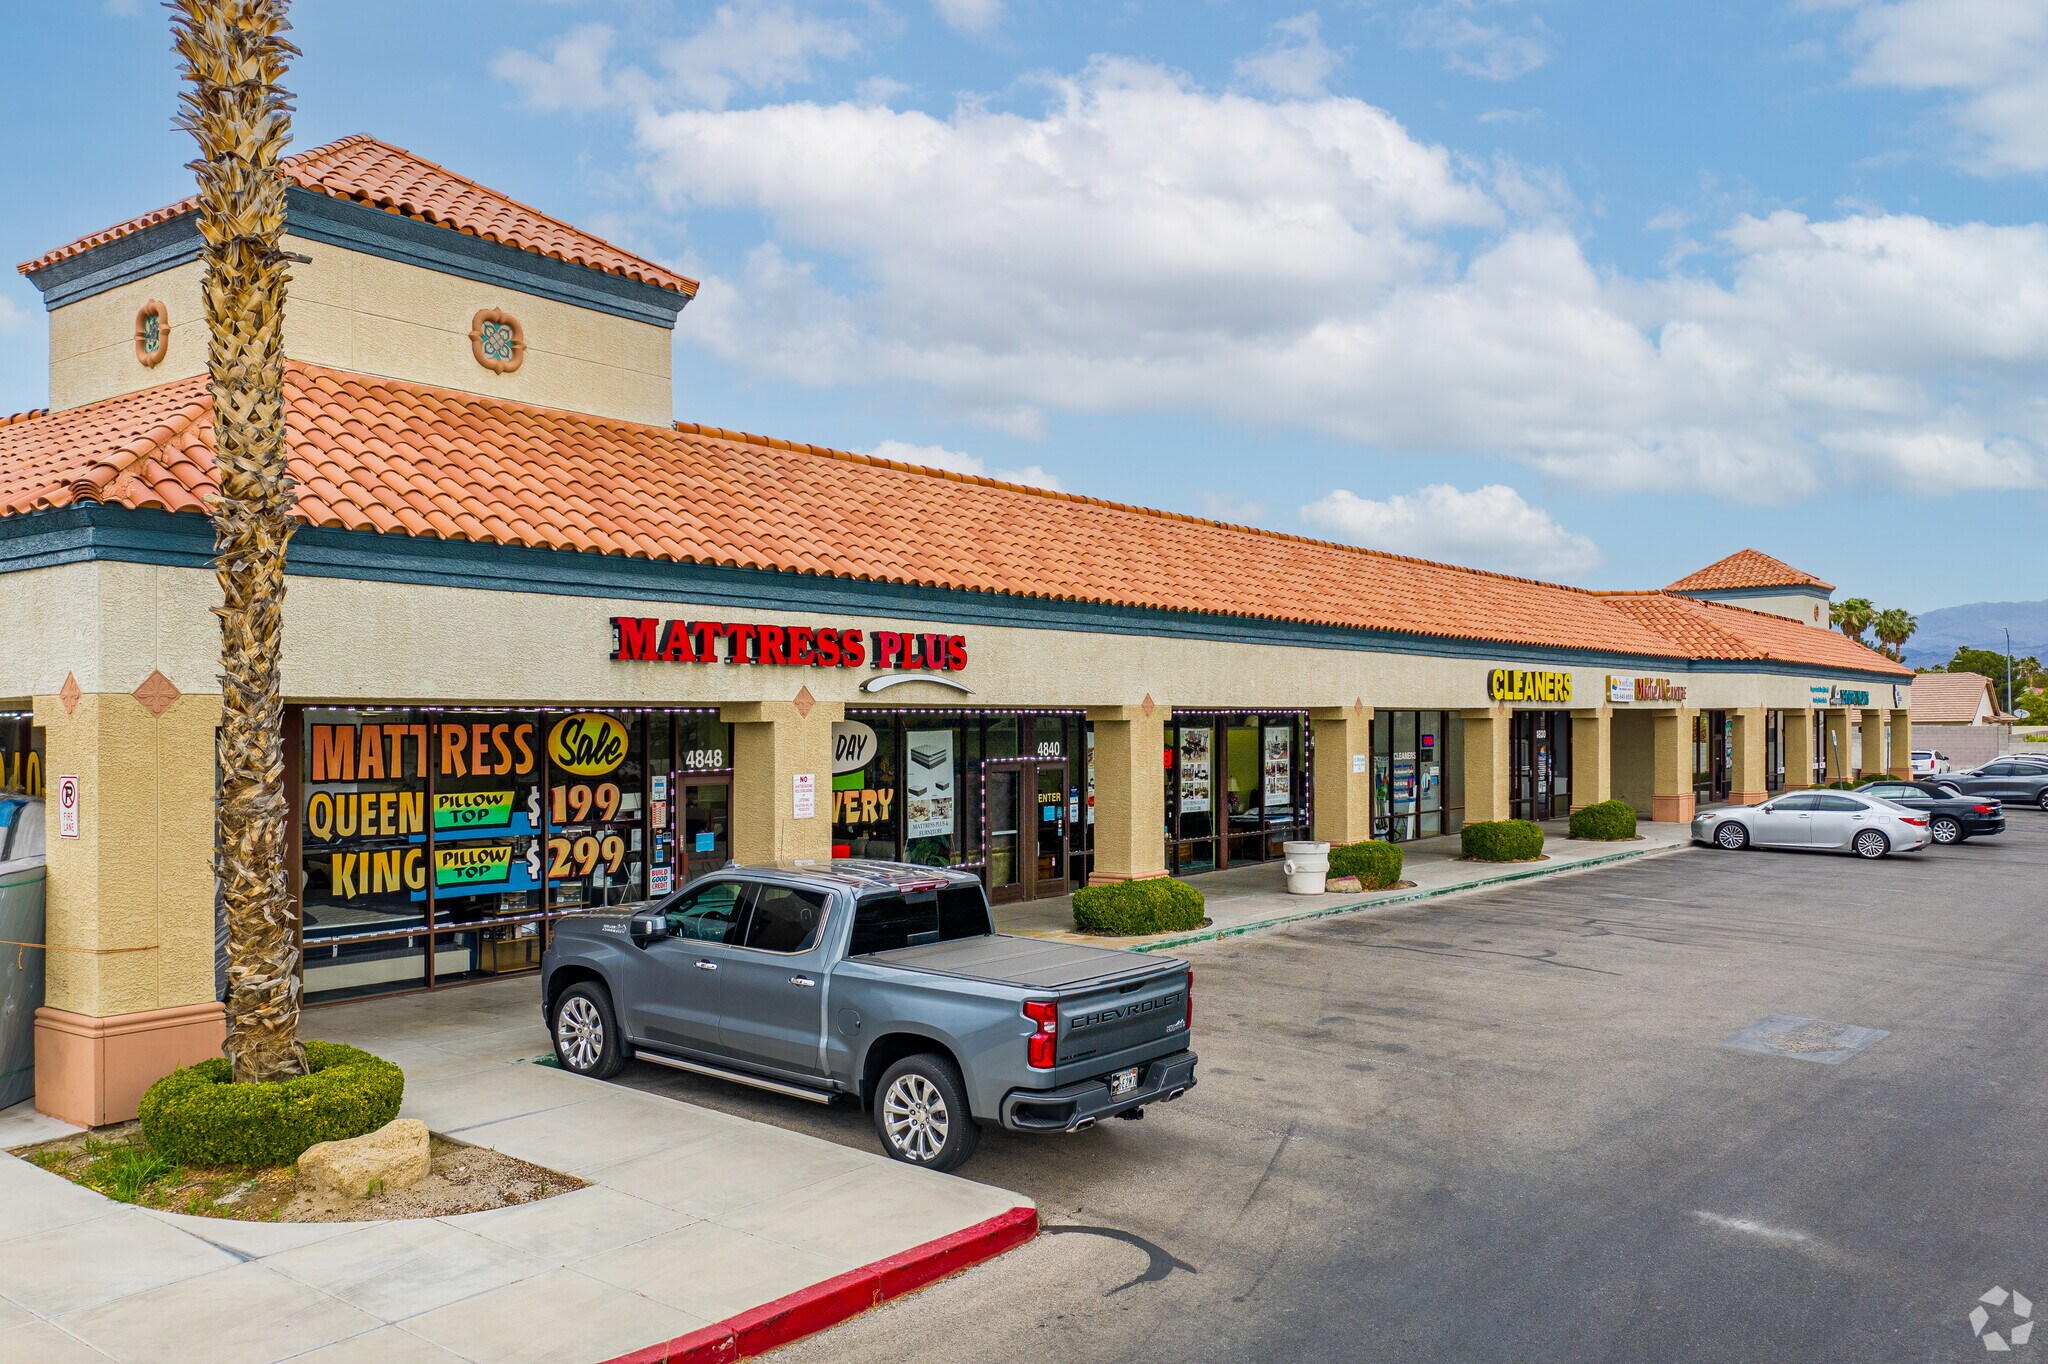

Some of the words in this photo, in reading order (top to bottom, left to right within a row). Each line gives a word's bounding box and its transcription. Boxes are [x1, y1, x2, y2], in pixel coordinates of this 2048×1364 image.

[611, 616, 865, 668] MATTRESS
[871, 631, 968, 672] PLUS
[1490, 668, 1573, 702] CLEANERS
[311, 723, 535, 781] MATTRESS
[558, 718, 623, 767] Sale
[835, 734, 868, 762] DAY
[1037, 741, 1060, 757] 4840
[1393, 751, 1417, 760] CLEANERS
[686, 749, 723, 769] 4848
[799, 775, 808, 783] NO
[438, 793, 505, 809] PILLOW
[1038, 792, 1061, 803] ENTER
[64, 812, 73, 821] FIRE
[308, 791, 425, 842] QUEEN
[449, 808, 490, 824] TOP
[64, 823, 74, 831] LANE
[912, 822, 936, 830] MATTRESS
[918, 828, 943, 836] FURNITURE
[442, 848, 508, 867] PILLOW
[332, 848, 426, 900] KING
[452, 865, 492, 879] TOP
[1071, 992, 1184, 1030] CHEVROLET
